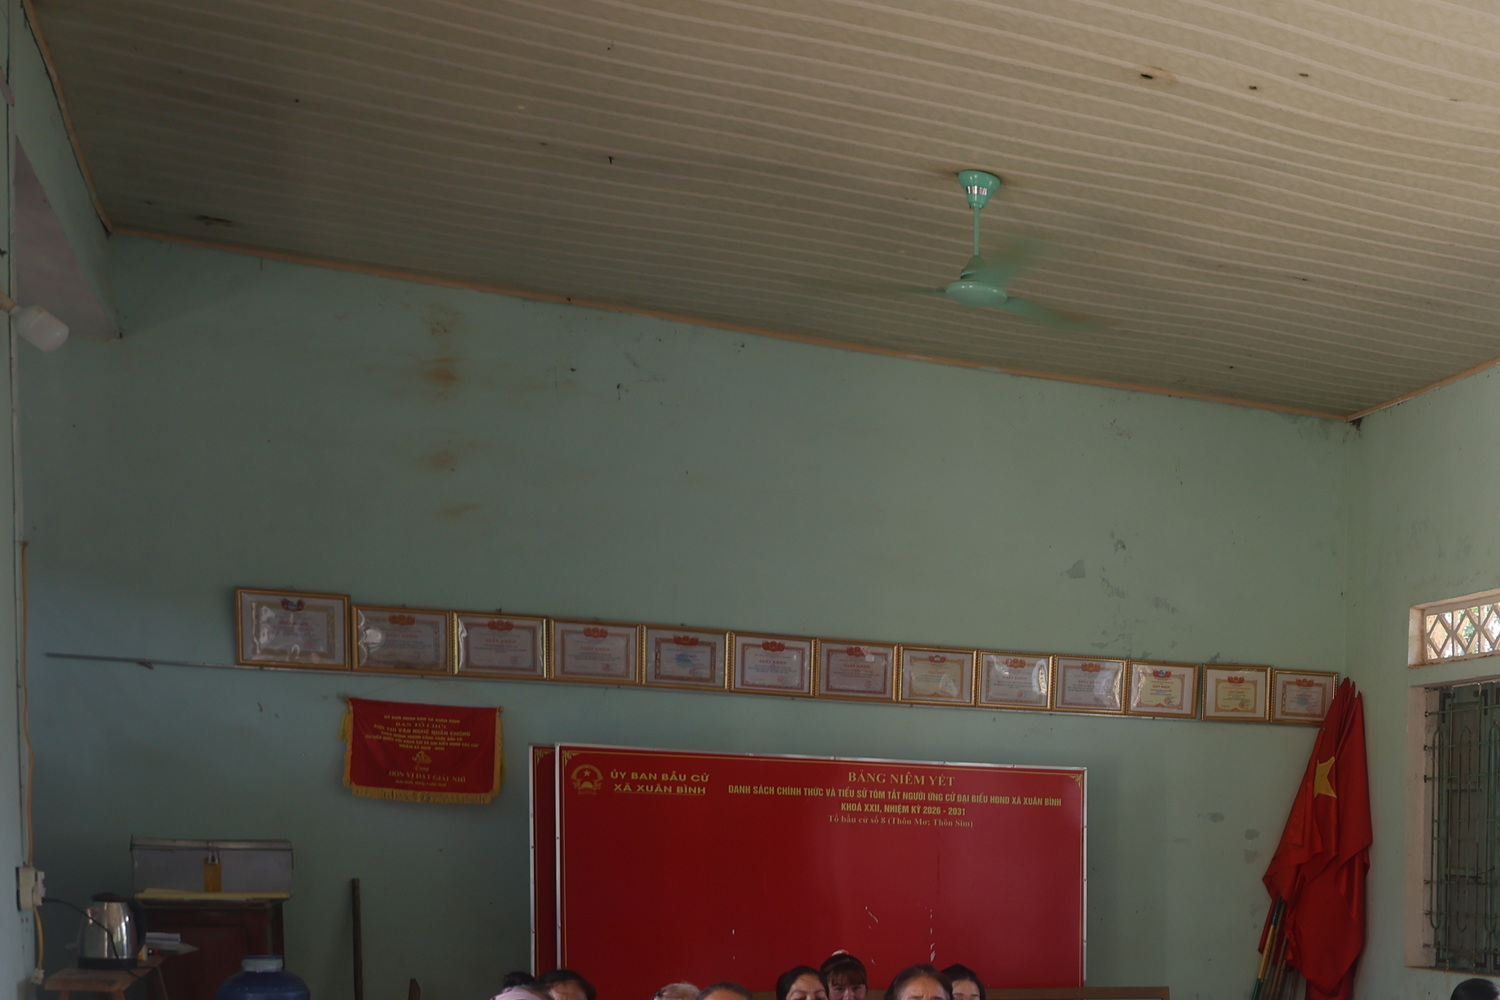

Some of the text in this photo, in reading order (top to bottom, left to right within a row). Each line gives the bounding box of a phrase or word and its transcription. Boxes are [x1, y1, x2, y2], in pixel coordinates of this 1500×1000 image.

[631, 772, 657, 781] BAN
[661, 770, 687, 782] BẦU
[690, 772, 710, 783] CỬ
[848, 769, 956, 787] BẢNG NIÊM YẾT
[614, 782, 707, 795] XÃ XUÂN BÌNH
[728, 784, 751, 794] DANH
[753, 784, 775, 796] SÁCH
[777, 785, 802, 797] CHÍNH
[804, 786, 824, 797] THỨC
[826, 787, 836, 798] VÀ
[903, 790, 926, 802] NGƯỜI
[1023, 796, 1043, 806] XUÂN
[1044, 797, 1062, 807] BÌNH
[841, 801, 862, 812] KHOÁ
[884, 804, 909, 816] NHIỆM
[922, 806, 942, 816] 2026
[948, 807, 966, 816] 2031
[881, 817, 887, 825] 8
